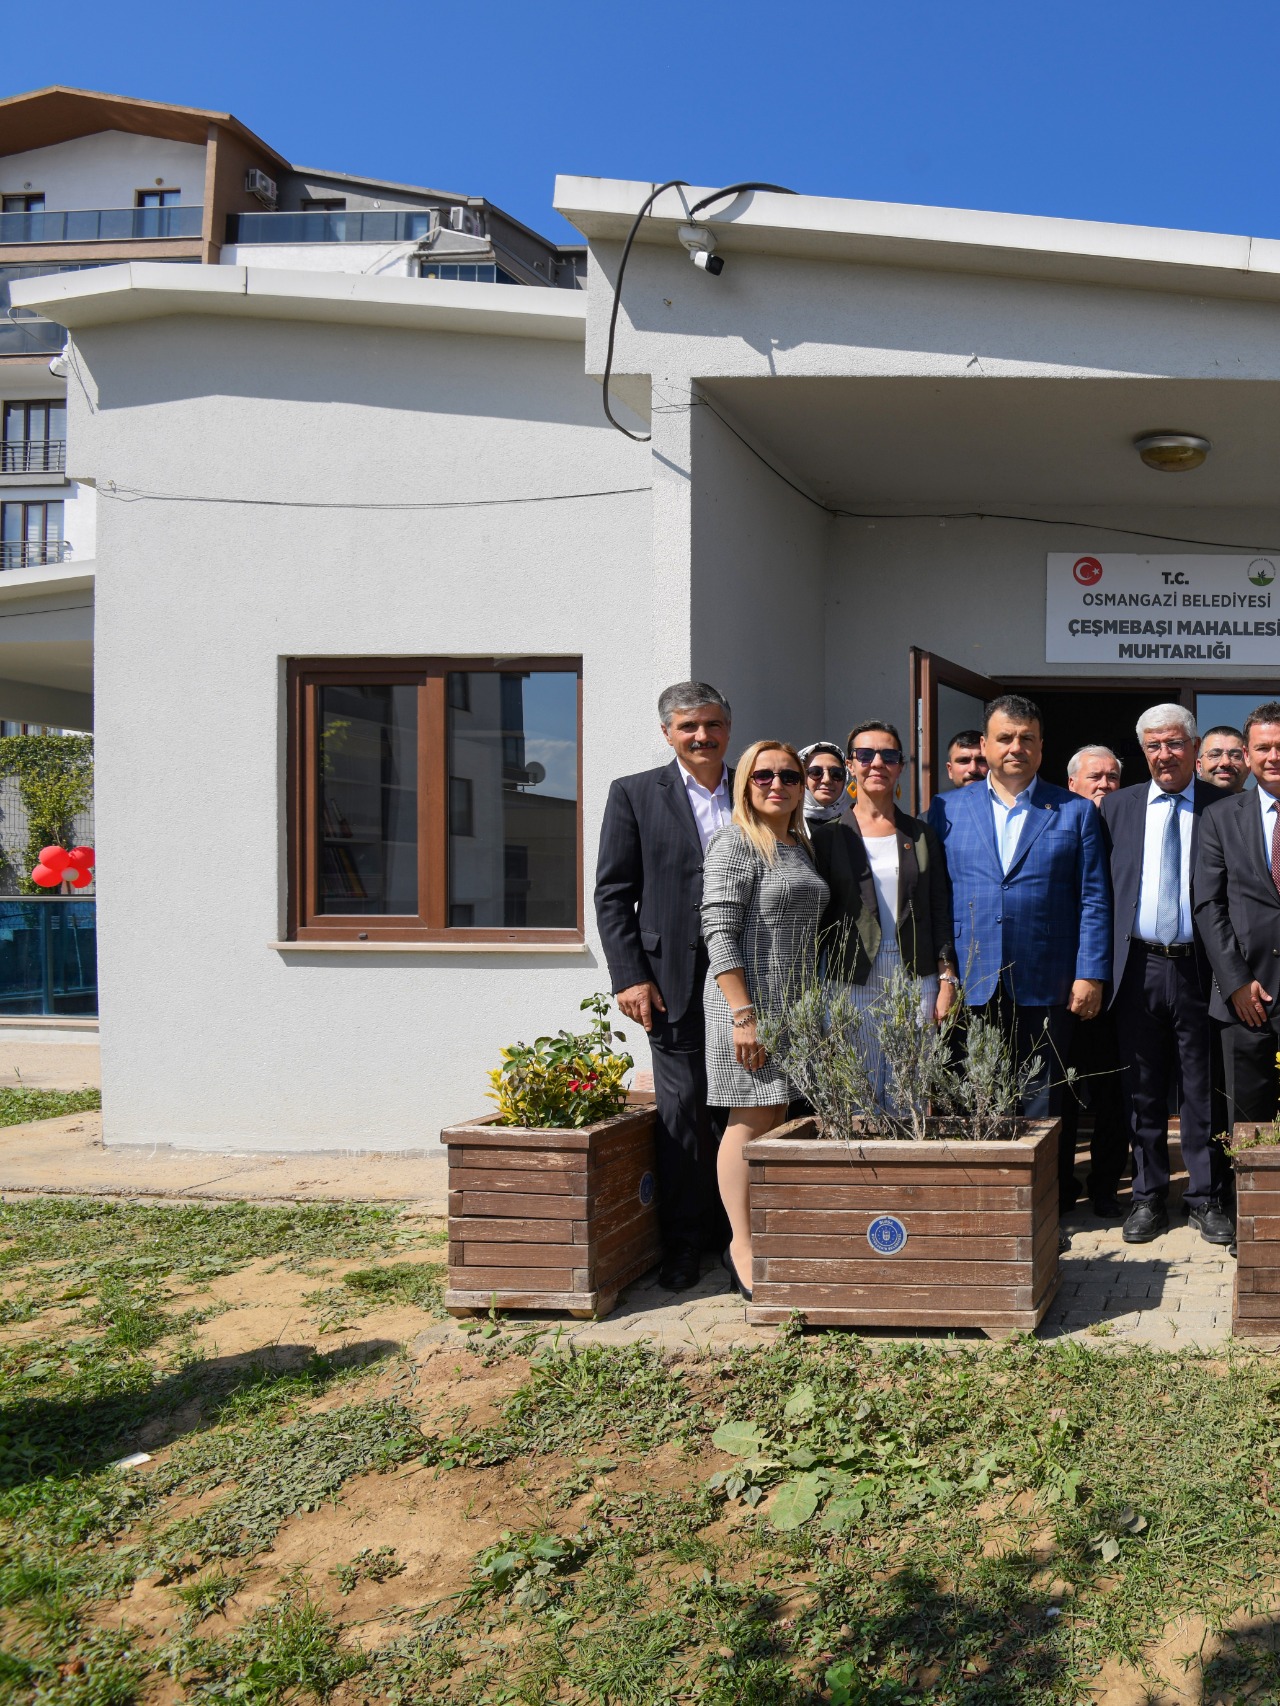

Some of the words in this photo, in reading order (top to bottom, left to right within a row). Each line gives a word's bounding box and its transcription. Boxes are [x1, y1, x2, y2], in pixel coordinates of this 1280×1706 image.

[1161, 571, 1190, 585] T.C.
[1082, 591, 1177, 607] OSMANGAZİ
[1182, 591, 1271, 608] BELEDİYESİ
[1068, 618, 1173, 637] ÇEŞMEBAŞI
[1118, 640, 1231, 660] MUHTARLIĞI
